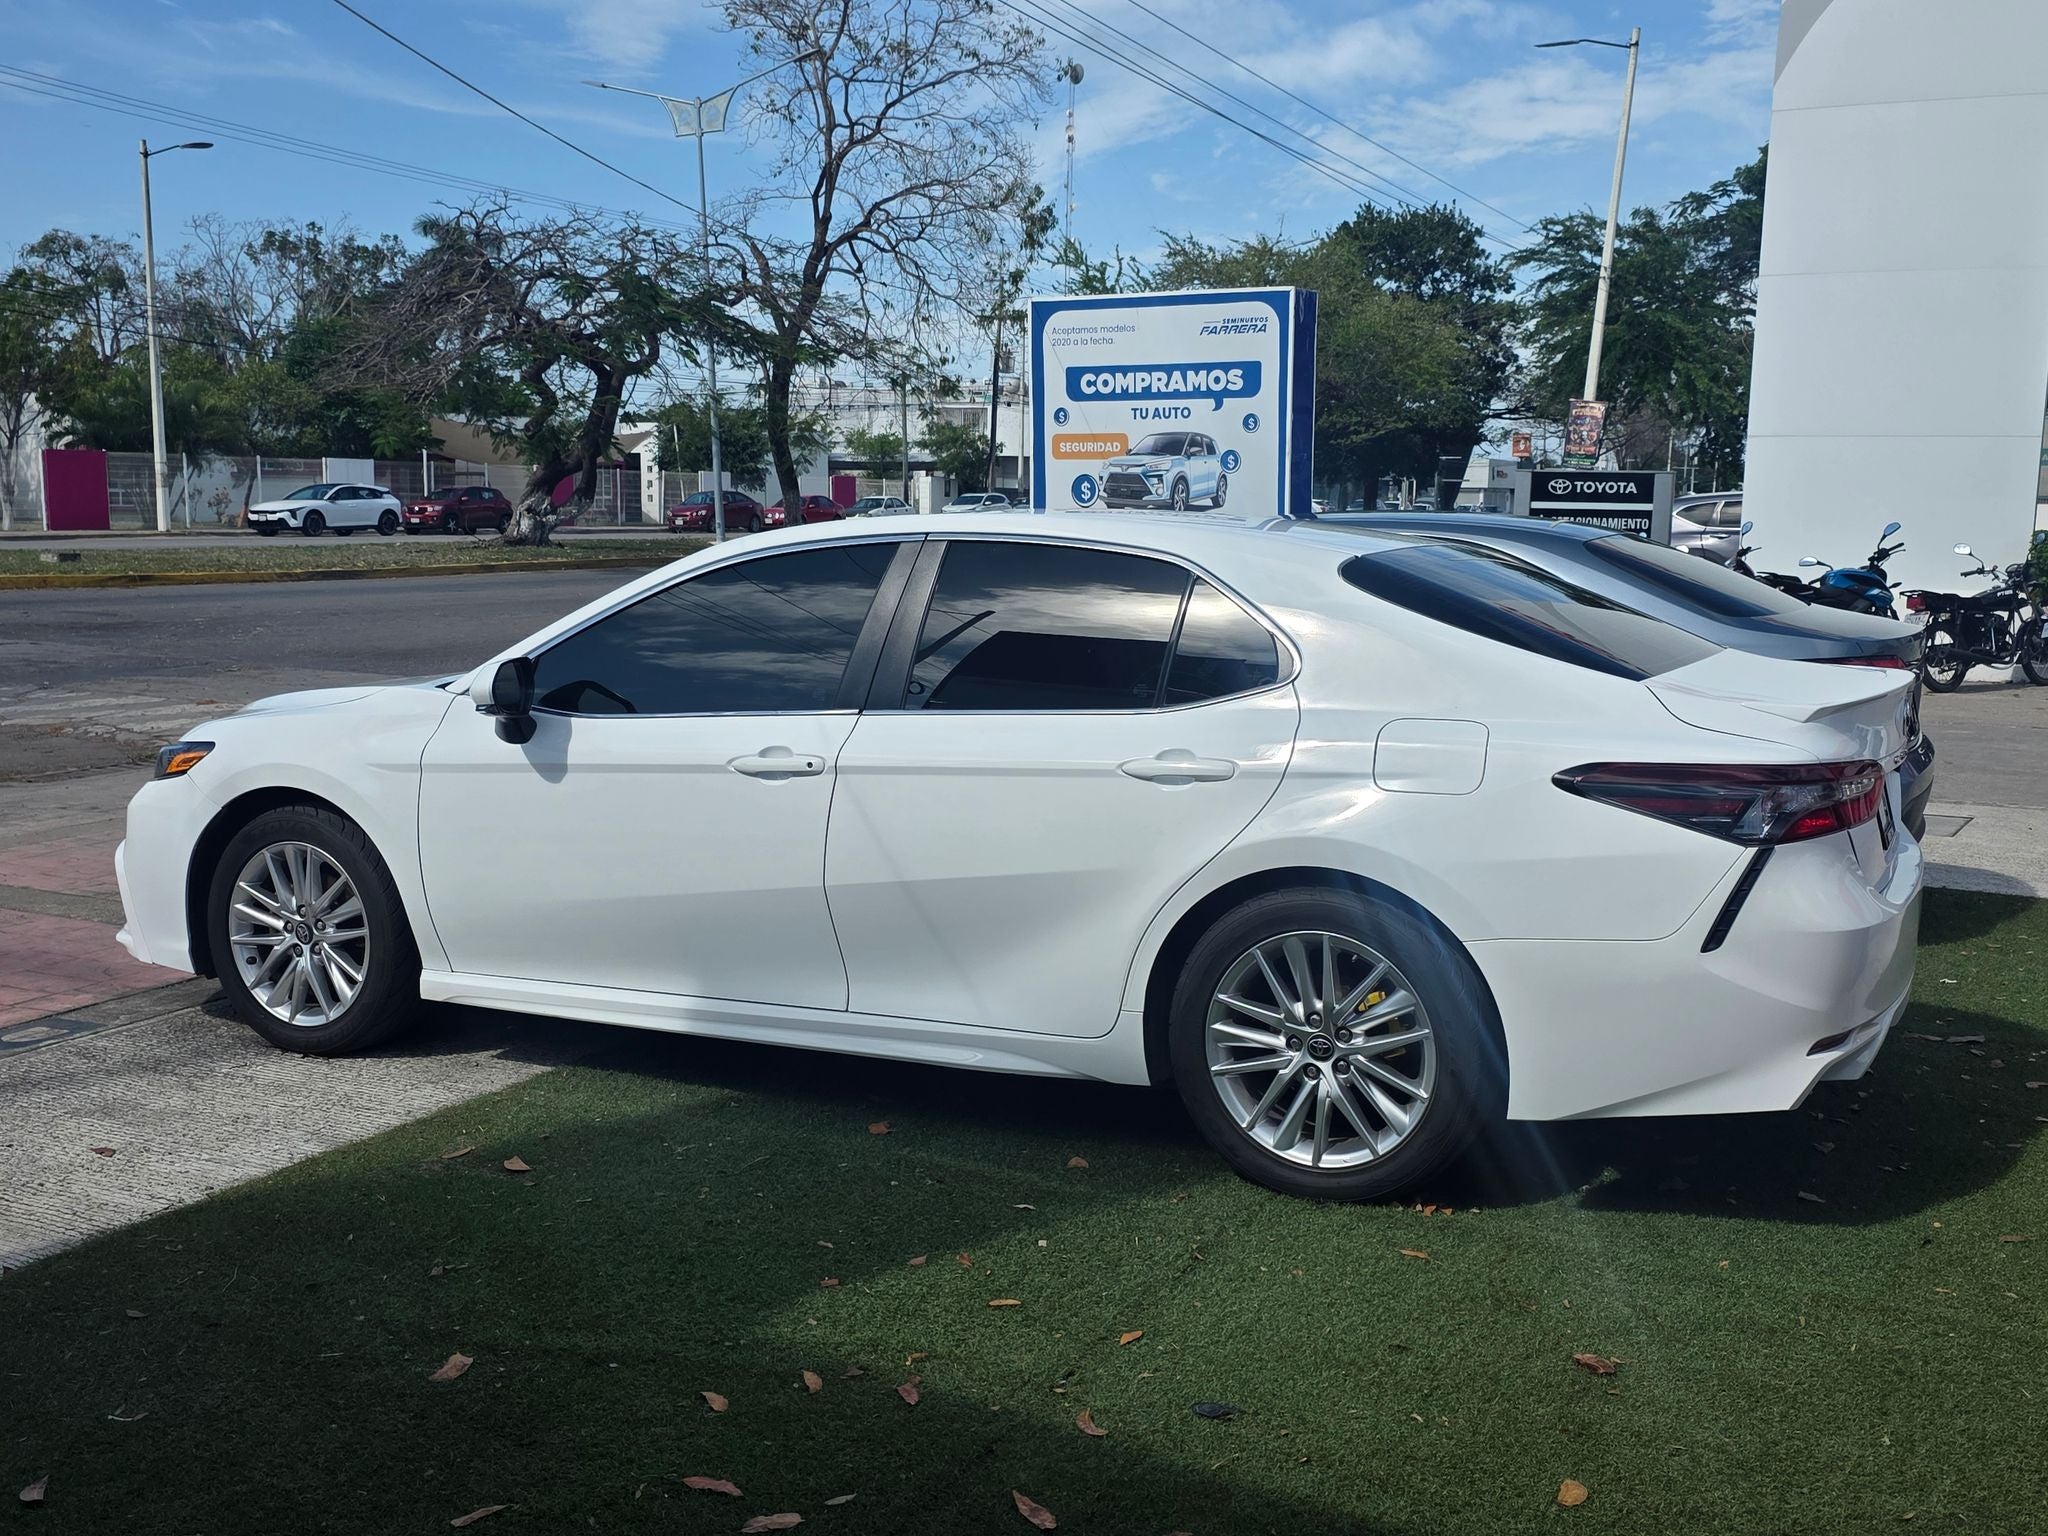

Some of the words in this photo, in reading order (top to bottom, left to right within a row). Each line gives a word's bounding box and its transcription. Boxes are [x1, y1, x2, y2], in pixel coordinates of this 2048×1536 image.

[1222, 316, 1269, 325] SEMINUEVOS
[1051, 326, 1098, 337] Aceptamos
[1099, 324, 1136, 334] modelos
[1199, 323, 1268, 336] FARRERA
[1051, 338, 1071, 347] 2020
[1080, 336, 1088, 346] la
[1089, 336, 1116, 346] fecha.
[1080, 369, 1243, 394] COMPRAMOS
[1131, 407, 1149, 420] TU
[1152, 406, 1192, 420] AUTO
[1059, 441, 1121, 453] SEGURIDAD
[1574, 481, 1638, 494] TOYOTA
[1551, 516, 1649, 529] ACIONAMIENTO
